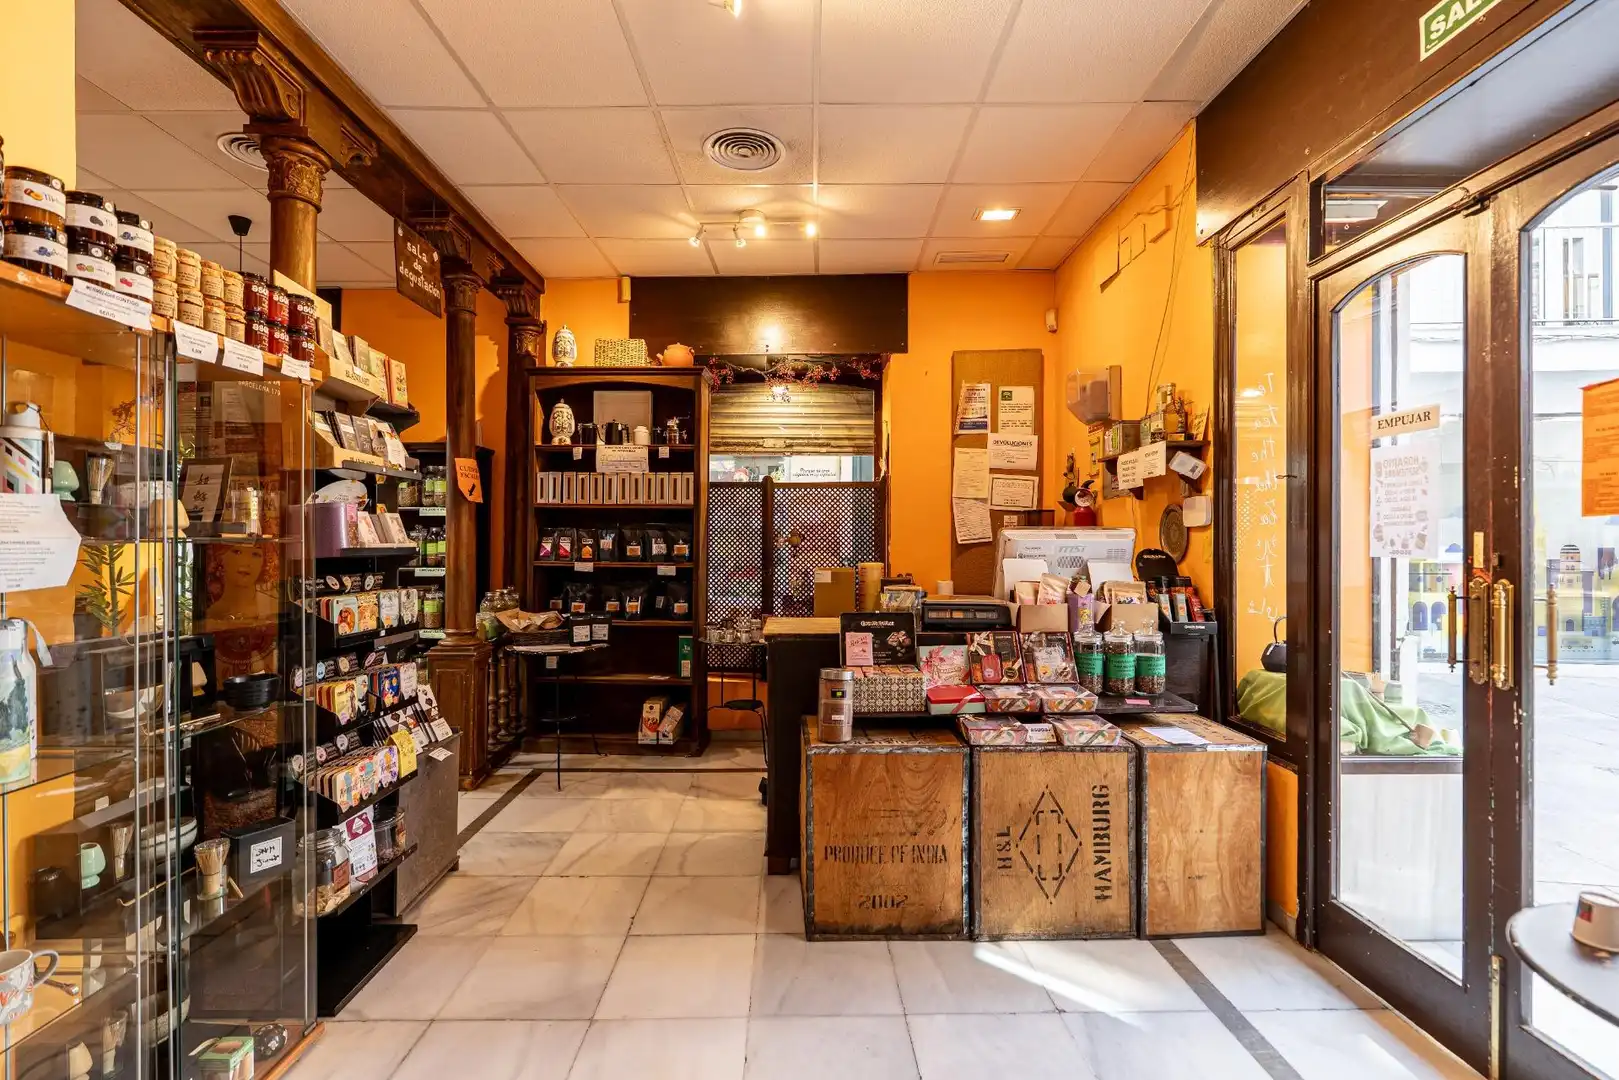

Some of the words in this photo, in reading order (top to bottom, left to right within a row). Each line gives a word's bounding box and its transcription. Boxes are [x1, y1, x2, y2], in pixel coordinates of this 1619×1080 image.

[407, 242, 428, 263] sala
[413, 259, 423, 274] de
[1377, 410, 1432, 430] EMPUJAR
[992, 439, 1033, 448] DEVOLUCIONES
[1091, 784, 1113, 901] HAMBURG
[823, 844, 887, 865] PRODUCE
[890, 845, 905, 864] OF
[912, 844, 948, 864] INDIA
